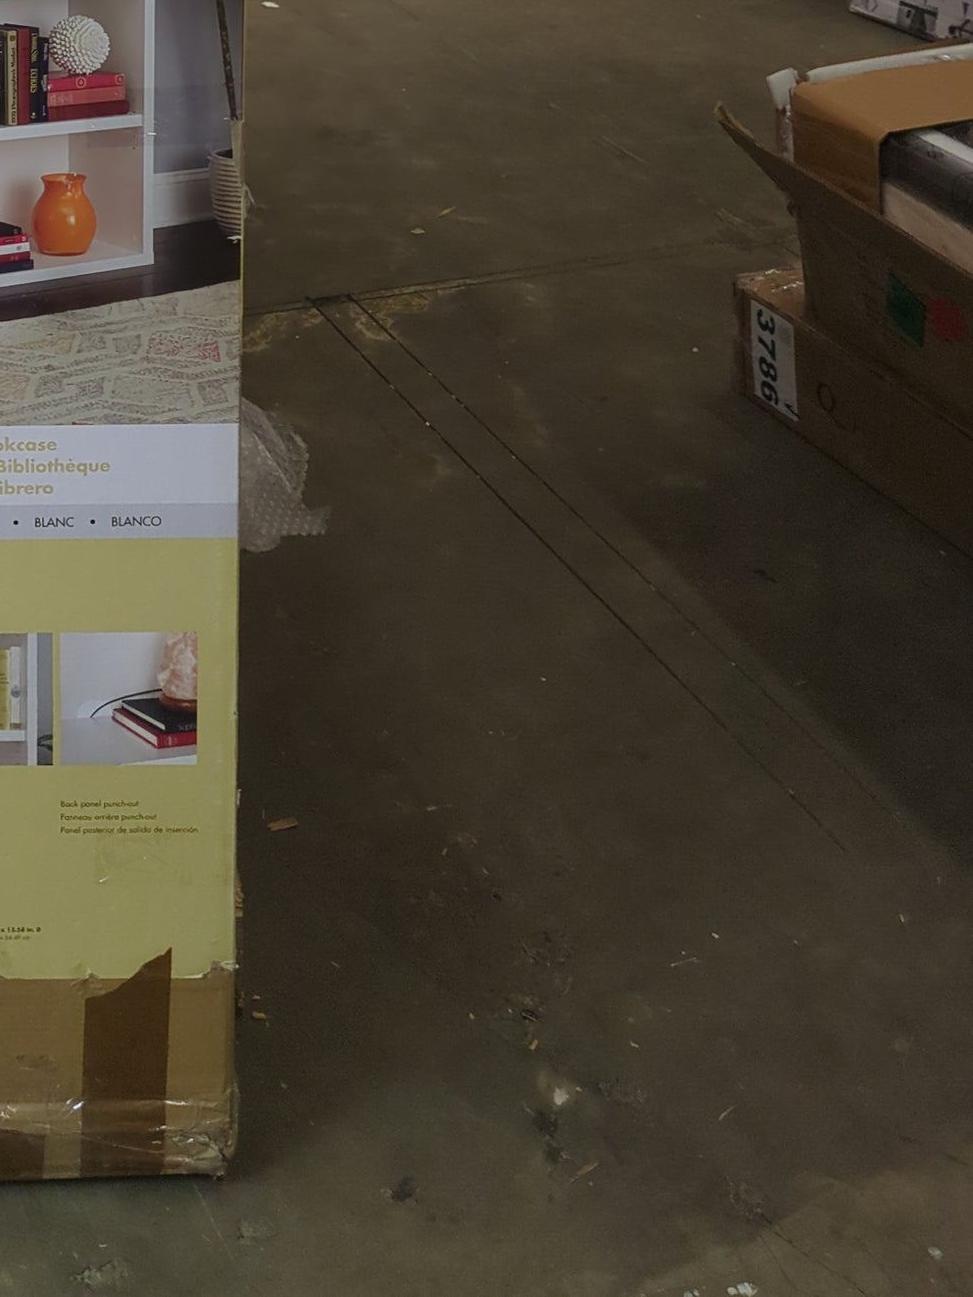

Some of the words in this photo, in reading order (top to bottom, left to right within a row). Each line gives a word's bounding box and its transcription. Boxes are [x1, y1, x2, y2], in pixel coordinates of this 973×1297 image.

[756, 308, 779, 405] 3786
[34, 516, 75, 529] BLANC
[110, 515, 163, 528] BLANCO
